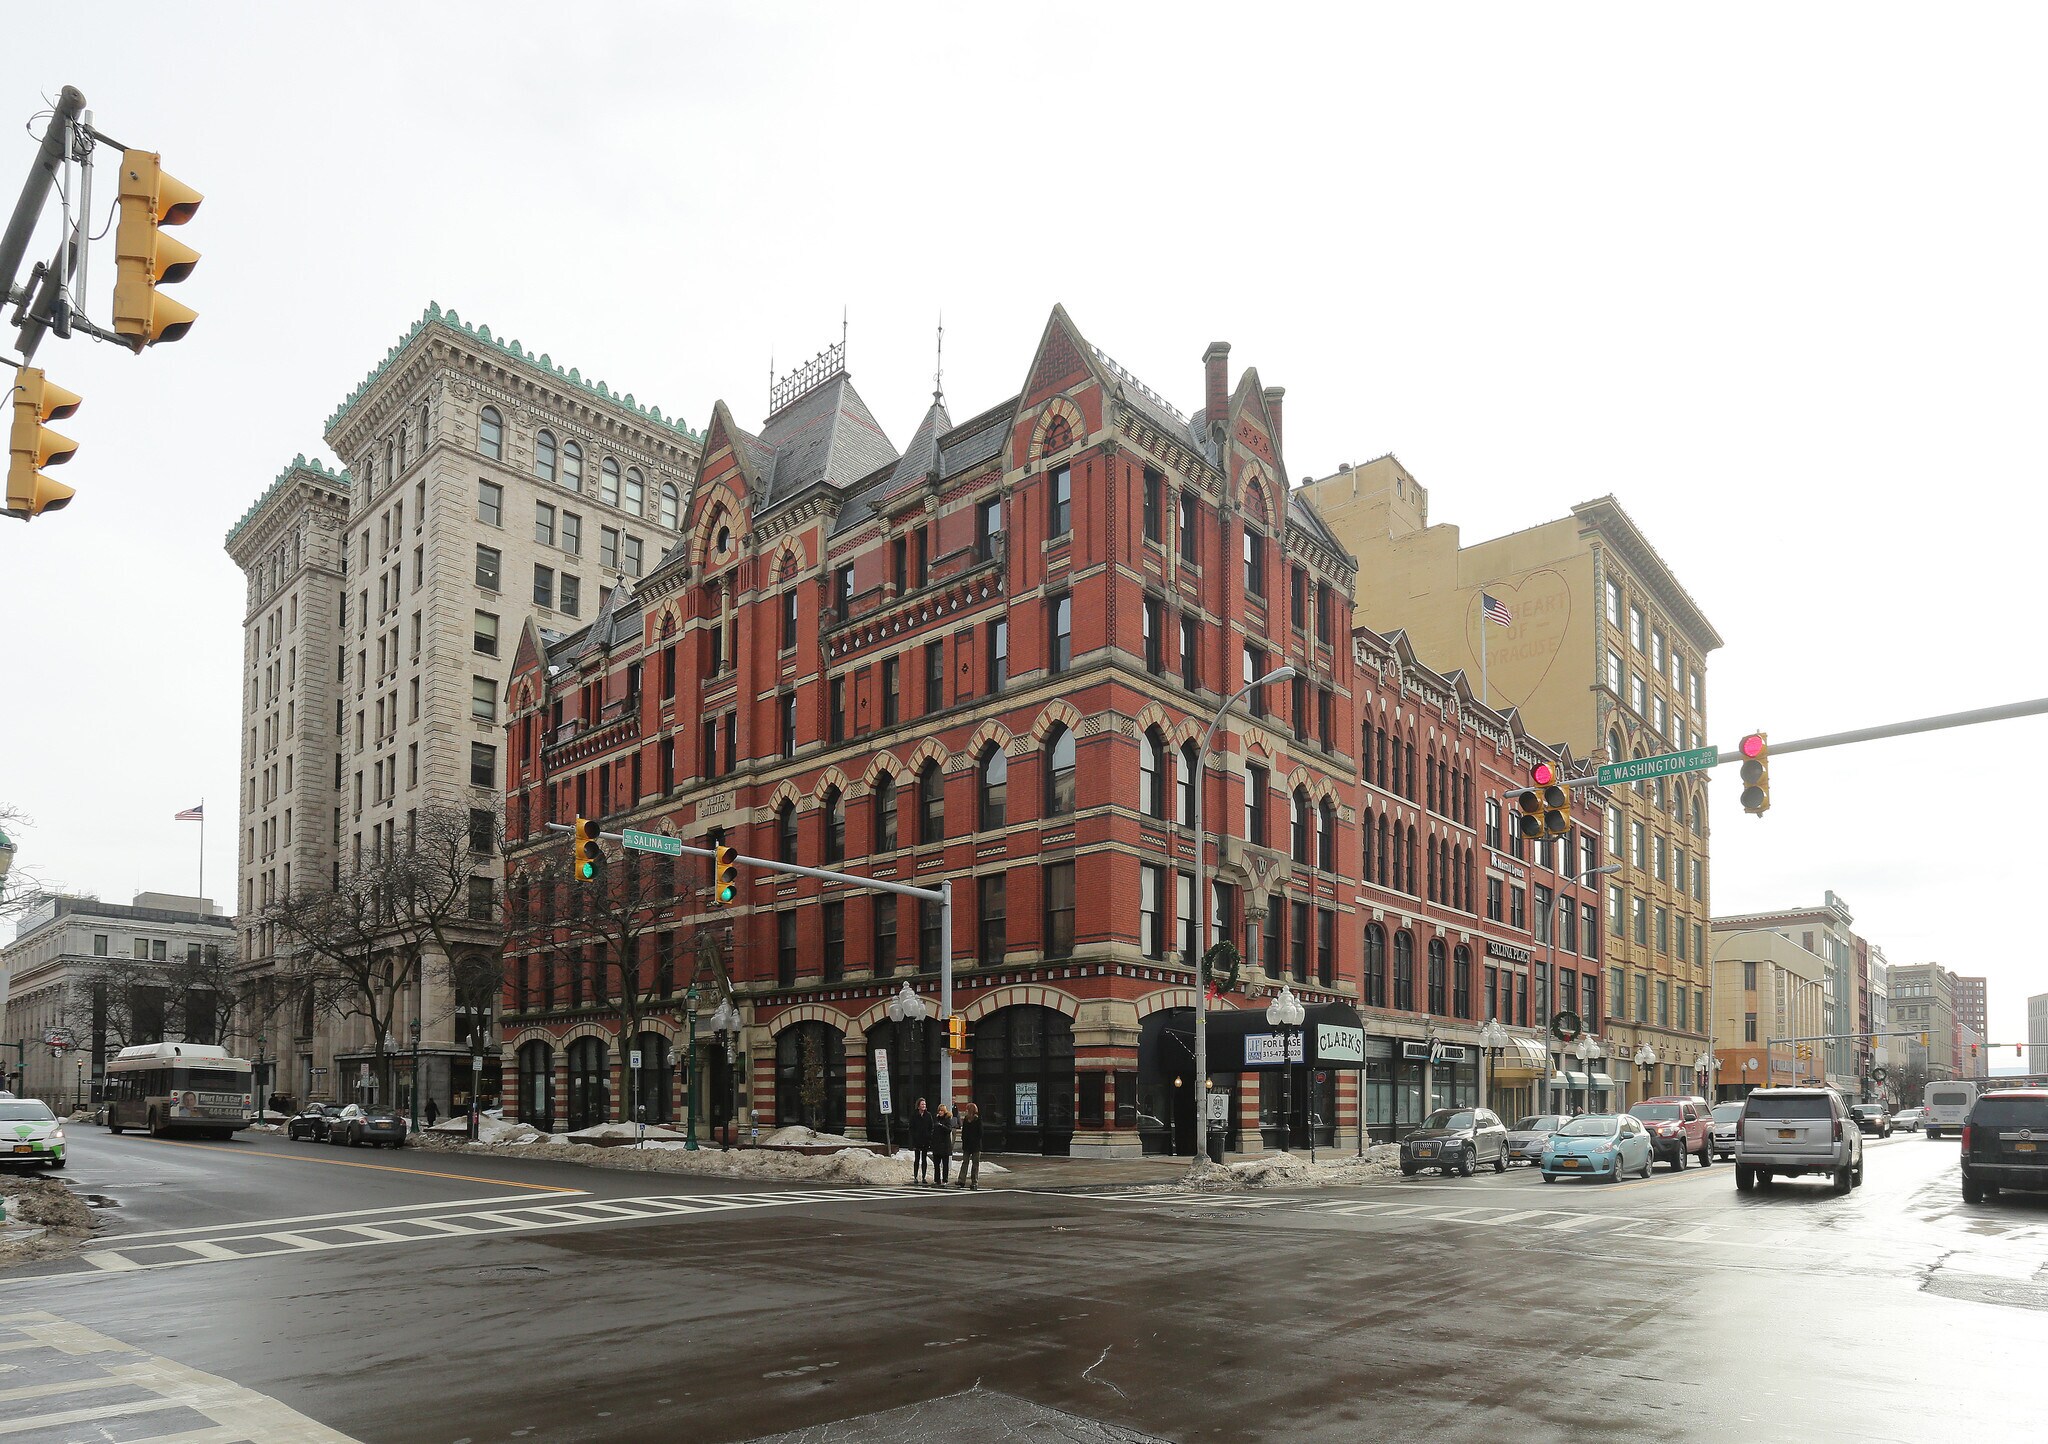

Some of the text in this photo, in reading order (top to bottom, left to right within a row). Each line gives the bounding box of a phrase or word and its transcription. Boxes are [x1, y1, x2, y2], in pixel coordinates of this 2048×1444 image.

[1510, 592, 1566, 620] HEART
[1507, 622, 1528, 640] OF
[1613, 756, 1699, 779] WASHINGTON ST
[1700, 757, 1714, 765] WEST
[1601, 774, 1611, 782] EAST
[700, 802, 730, 817] BUILDING
[633, 834, 663, 849] SALINA
[664, 843, 672, 851] ST
[1490, 942, 1512, 958] SALINA
[1263, 1039, 1301, 1048] FOR LASE
[1319, 1031, 1361, 1054] CLARK'S
[200, 1094, 215, 1102] Hurt
